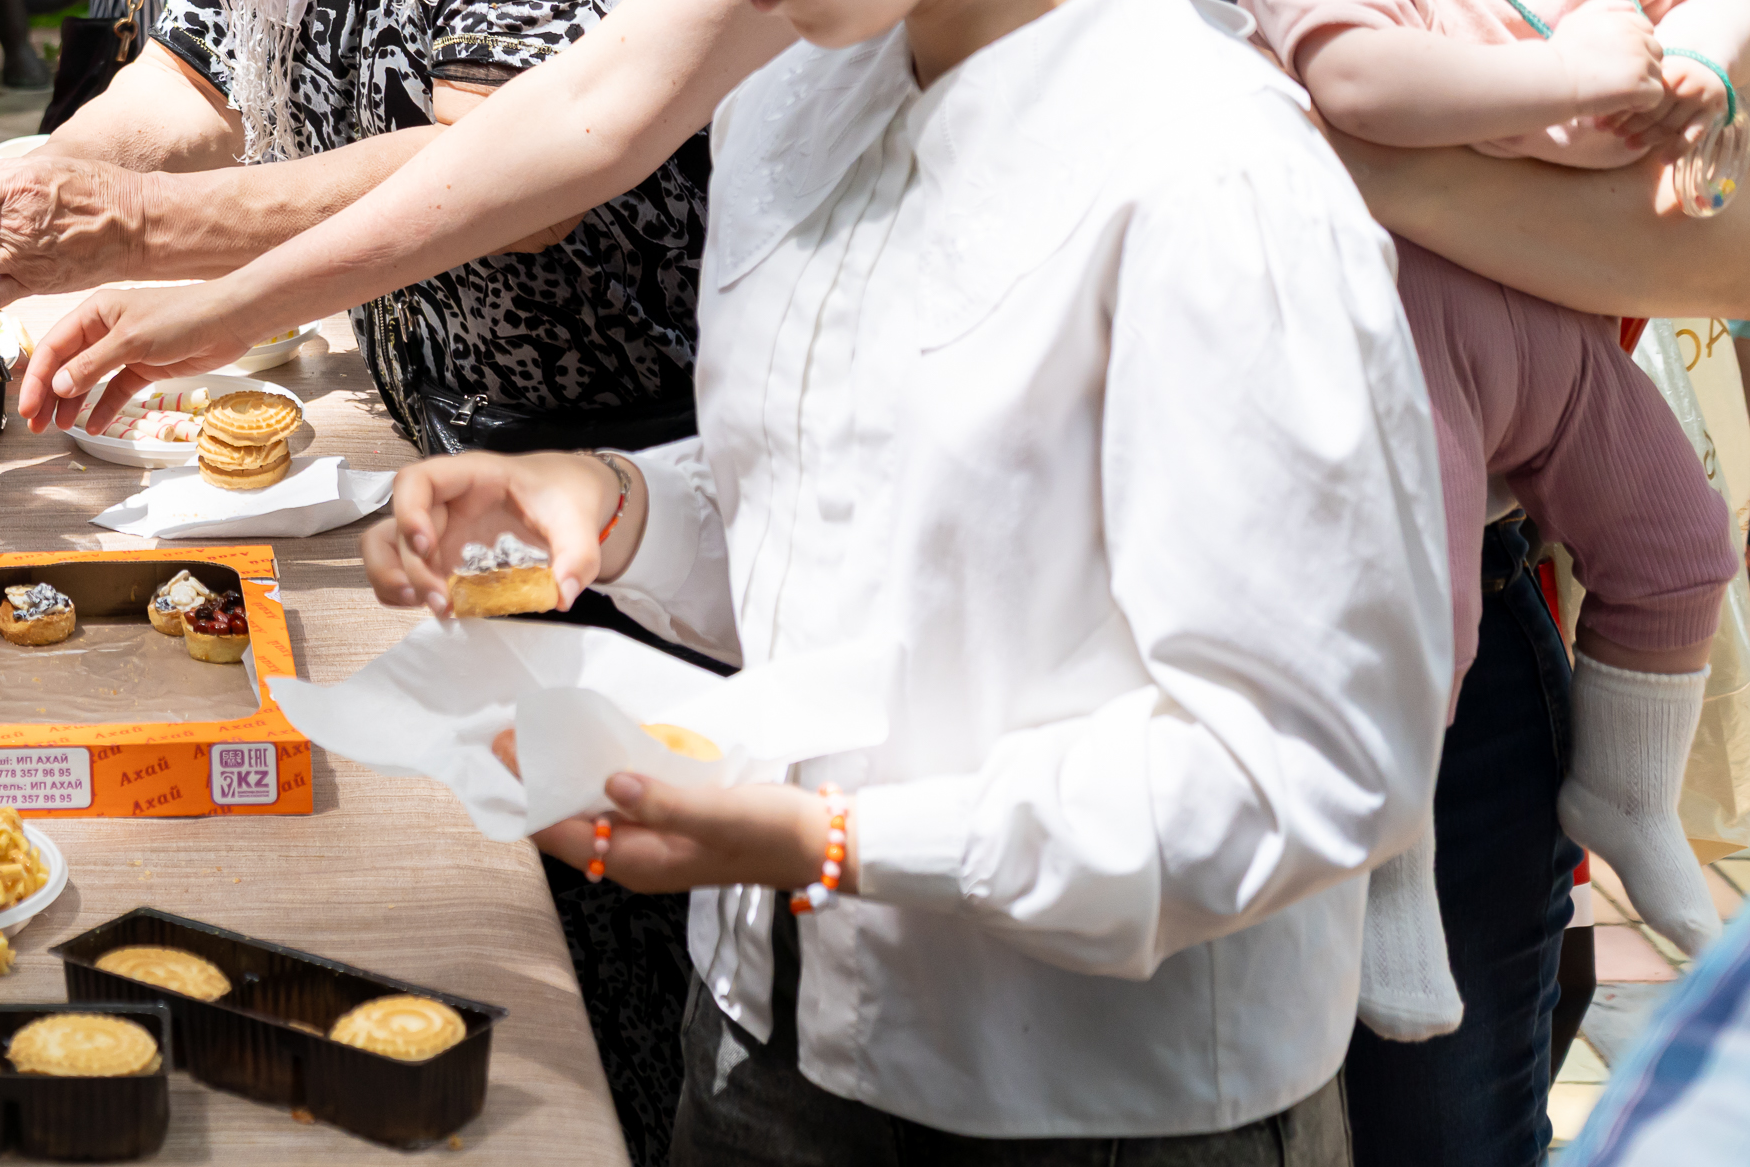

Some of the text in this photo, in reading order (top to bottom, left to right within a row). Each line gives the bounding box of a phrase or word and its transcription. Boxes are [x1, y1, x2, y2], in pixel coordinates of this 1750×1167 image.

[16, 756, 33, 765] ИП
[36, 753, 68, 765] АХАЙ
[20, 768, 39, 778] 357
[42, 768, 55, 777] 96
[58, 768, 72, 777] 95
[120, 756, 172, 788] Ахай
[30, 781, 47, 790] ИП
[50, 779, 83, 790] АХАЙ
[237, 770, 270, 789] KZ
[0, 795, 18, 804] 778
[21, 794, 40, 804] 357
[43, 794, 56, 803] 96
[59, 793, 73, 803] 95
[132, 784, 184, 817] Ахай
